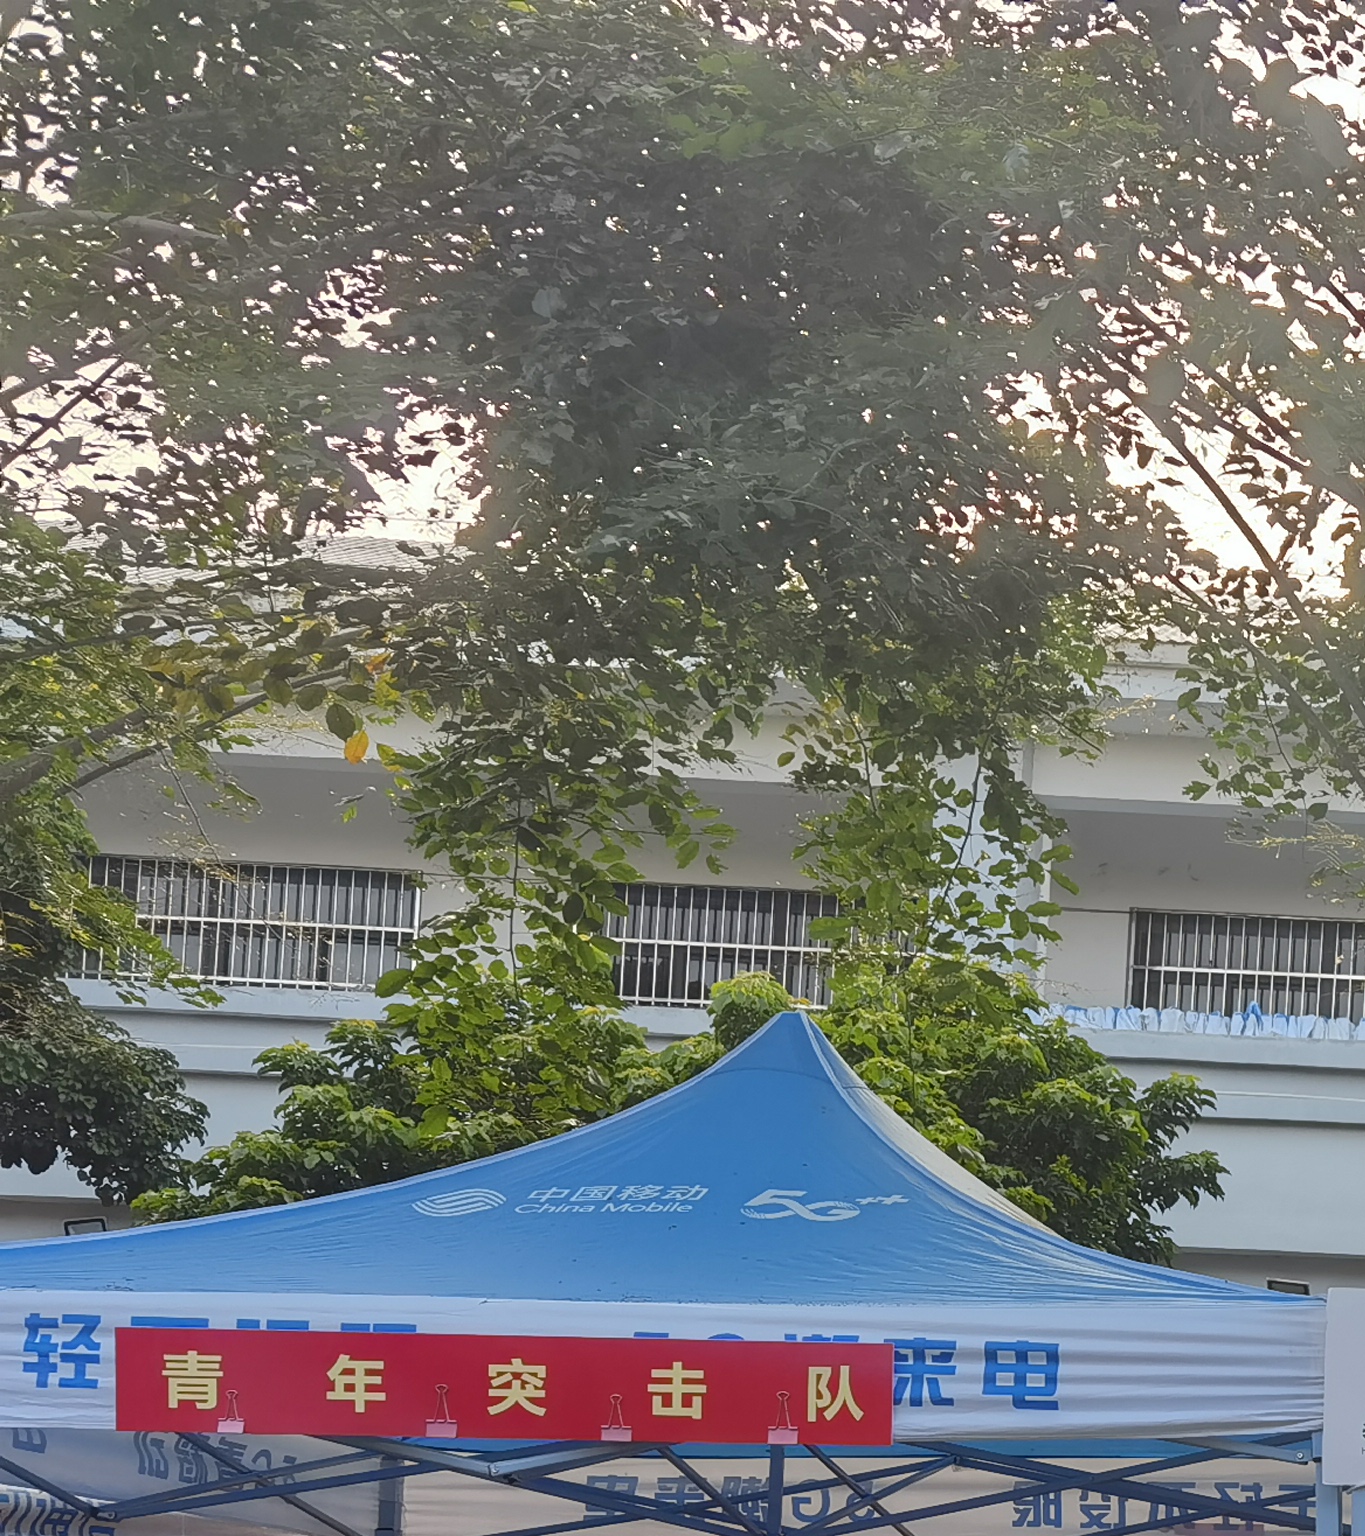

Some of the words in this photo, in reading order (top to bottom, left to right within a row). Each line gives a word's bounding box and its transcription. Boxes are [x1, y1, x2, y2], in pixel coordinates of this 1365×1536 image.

[526, 1183, 708, 1204] 中国移动
[514, 1202, 597, 1214] China
[601, 1202, 694, 1214] Mobile
[161, 1349, 865, 1423] 青年突击队
